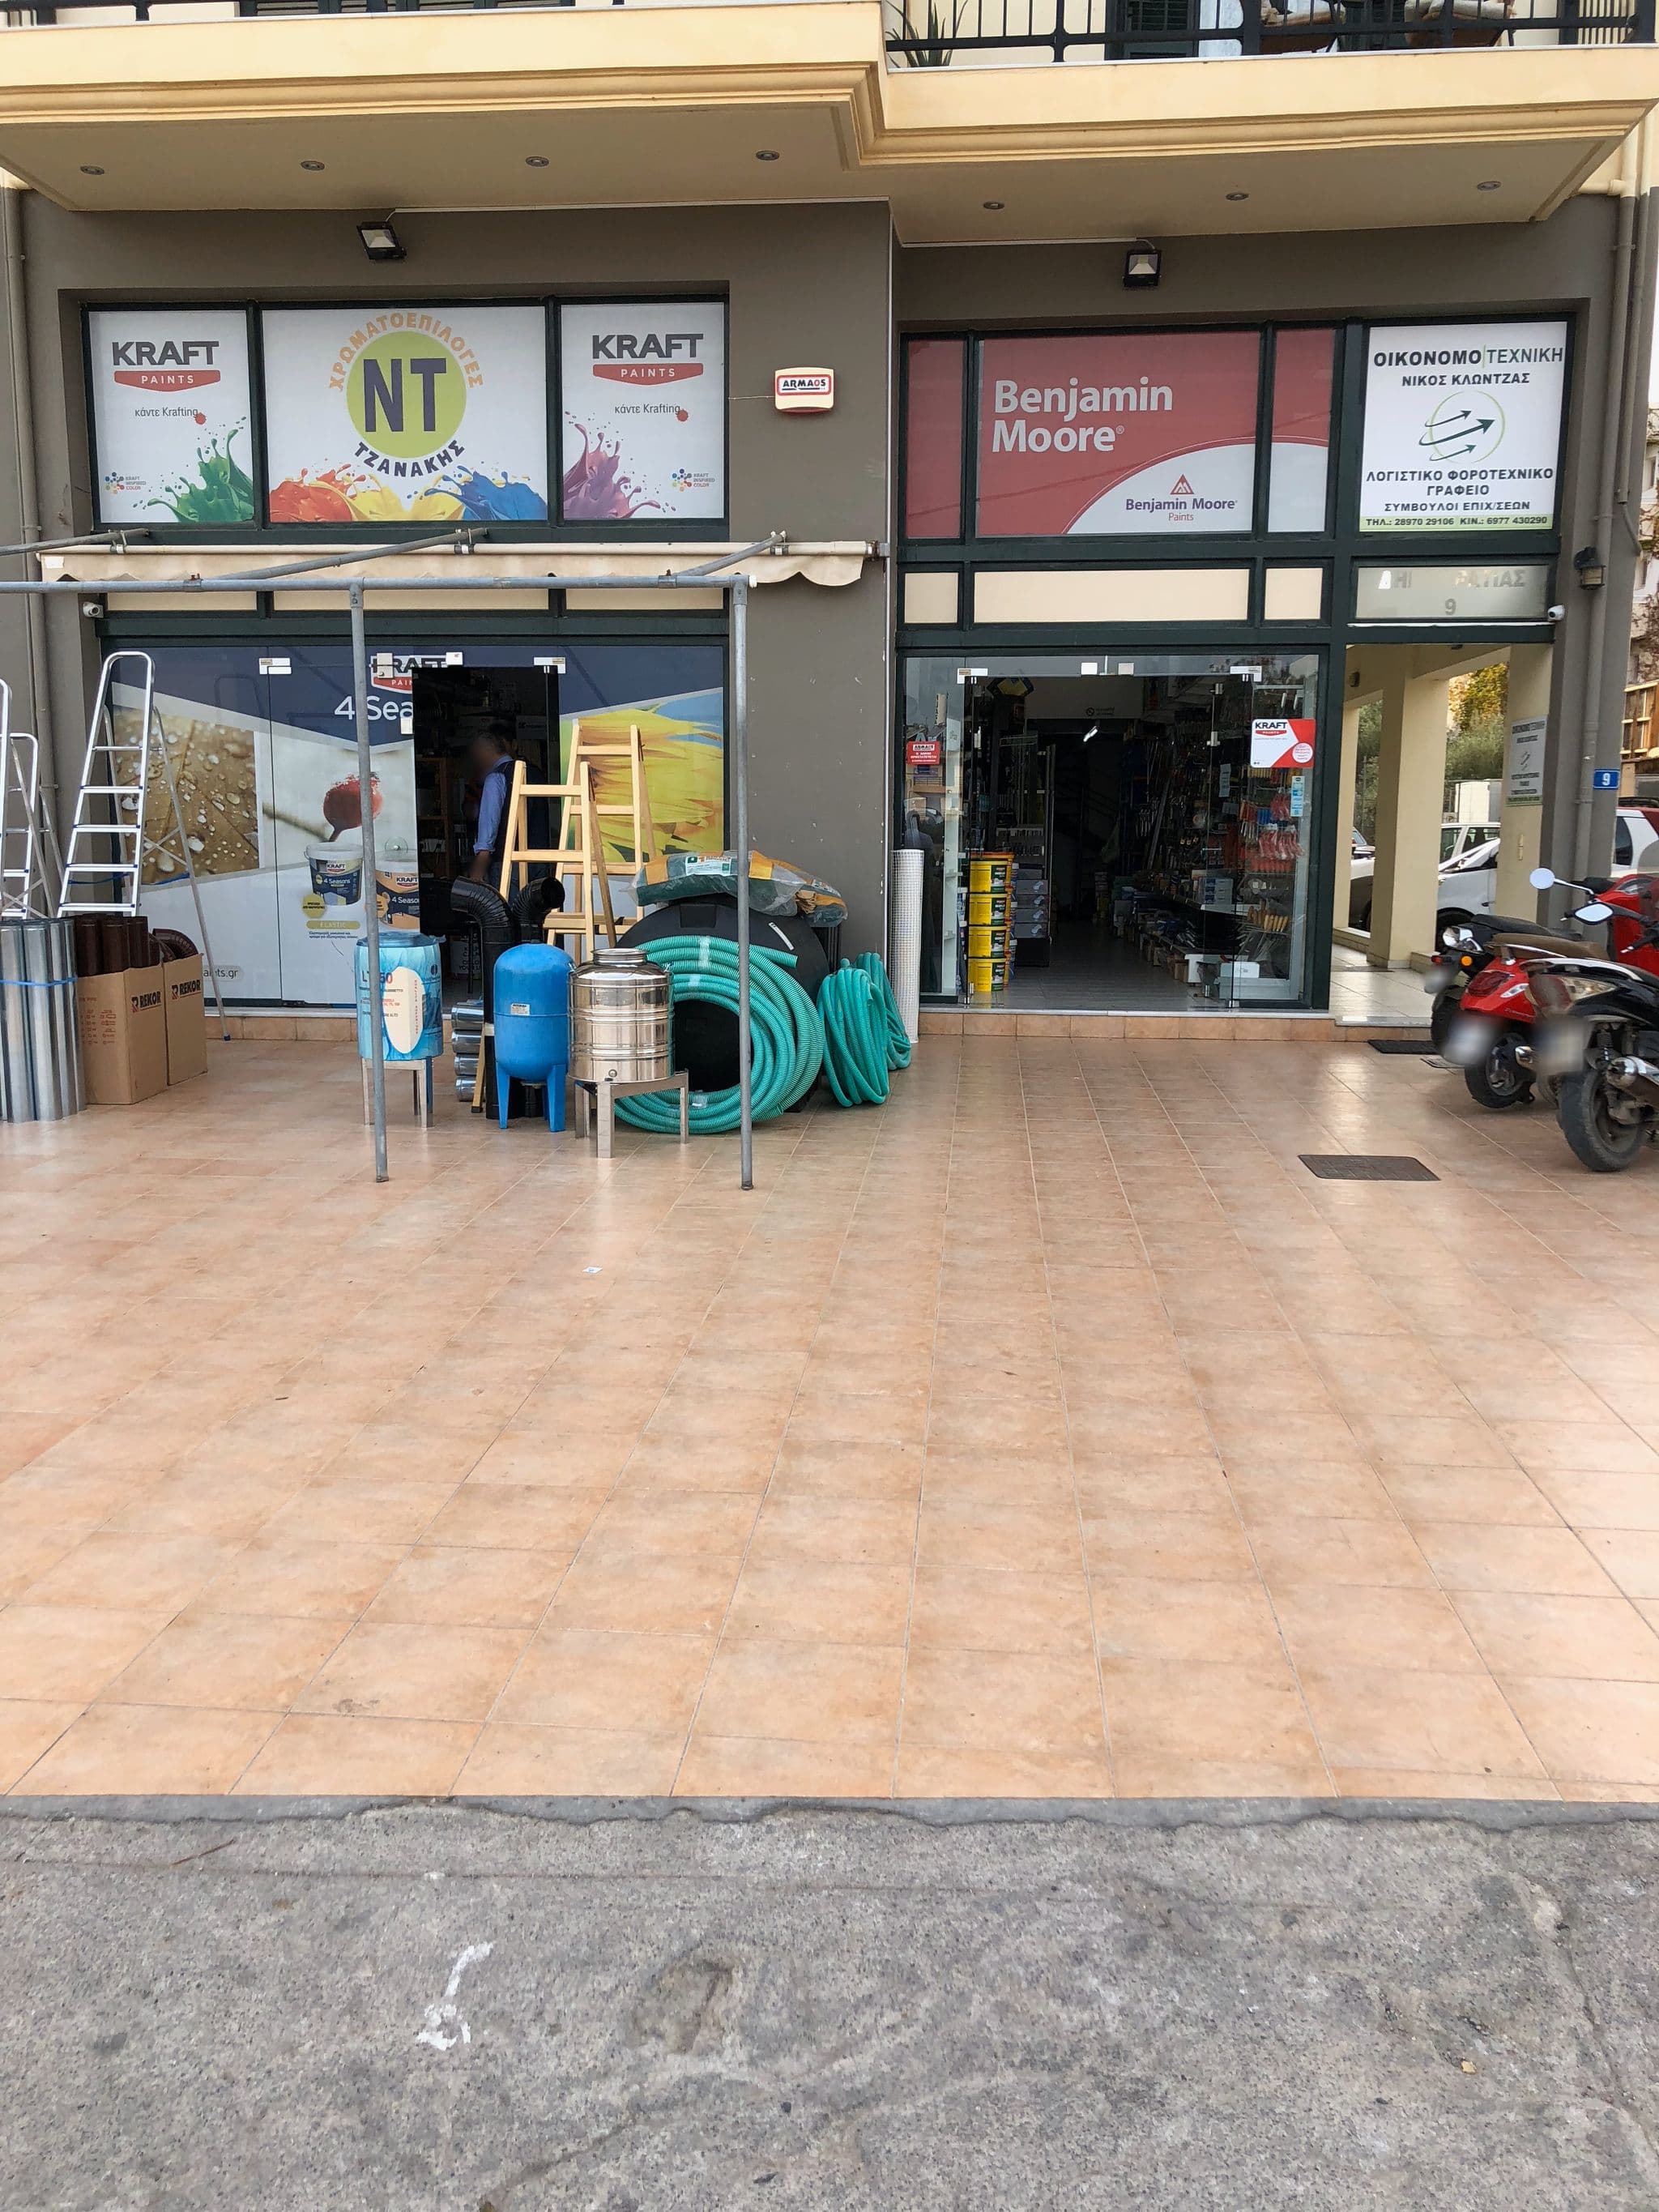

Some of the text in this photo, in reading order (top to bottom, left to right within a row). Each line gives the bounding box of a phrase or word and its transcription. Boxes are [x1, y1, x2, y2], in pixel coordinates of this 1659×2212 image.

[112, 341, 220, 366] KRAFT
[329, 312, 484, 392] ΧΡΩΜΑΤΟΕΠΙΛΟΓΕΣ
[592, 334, 704, 359] KRAFT
[141, 375, 194, 384] PAINTS
[621, 368, 676, 378] PAINTS
[1401, 373, 1530, 386] ΝΙΚΟΣ ΚΛΩΝΤΖΑΣ
[783, 378, 826, 388] ARMAOS
[995, 376, 1173, 422] Benjamin
[134, 407, 198, 418] κάντε Krafting
[614, 404, 680, 416] κάντε Krafting
[354, 439, 465, 478] ΤΖΑΝΑΚΗΣ
[1366, 468, 1554, 482] ΛΟΓΙΣΤΙΚΟ ΦΟΡΟΤΕΧΝΙΚΟ
[1427, 485, 1490, 496] ΓΡΑΦΕΙΟ
[1126, 497, 1235, 513] Benjamin Moore
[1384, 501, 1530, 512] ΣΥΜΒΟΥΛΟΙ ΕΠΙΧ/ΣΕΩΝ
[1168, 512, 1194, 521] Paints
[1394, 518, 1423, 526] 28970
[1486, 517, 1510, 525] 6977
[1512, 516, 1548, 524] 430290
[1444, 598, 1456, 615] 9
[334, 695, 356, 720] 4
[1601, 772, 1610, 786] 9
[179, 979, 201, 996] REKOR
[139, 990, 161, 1008] REKOR
